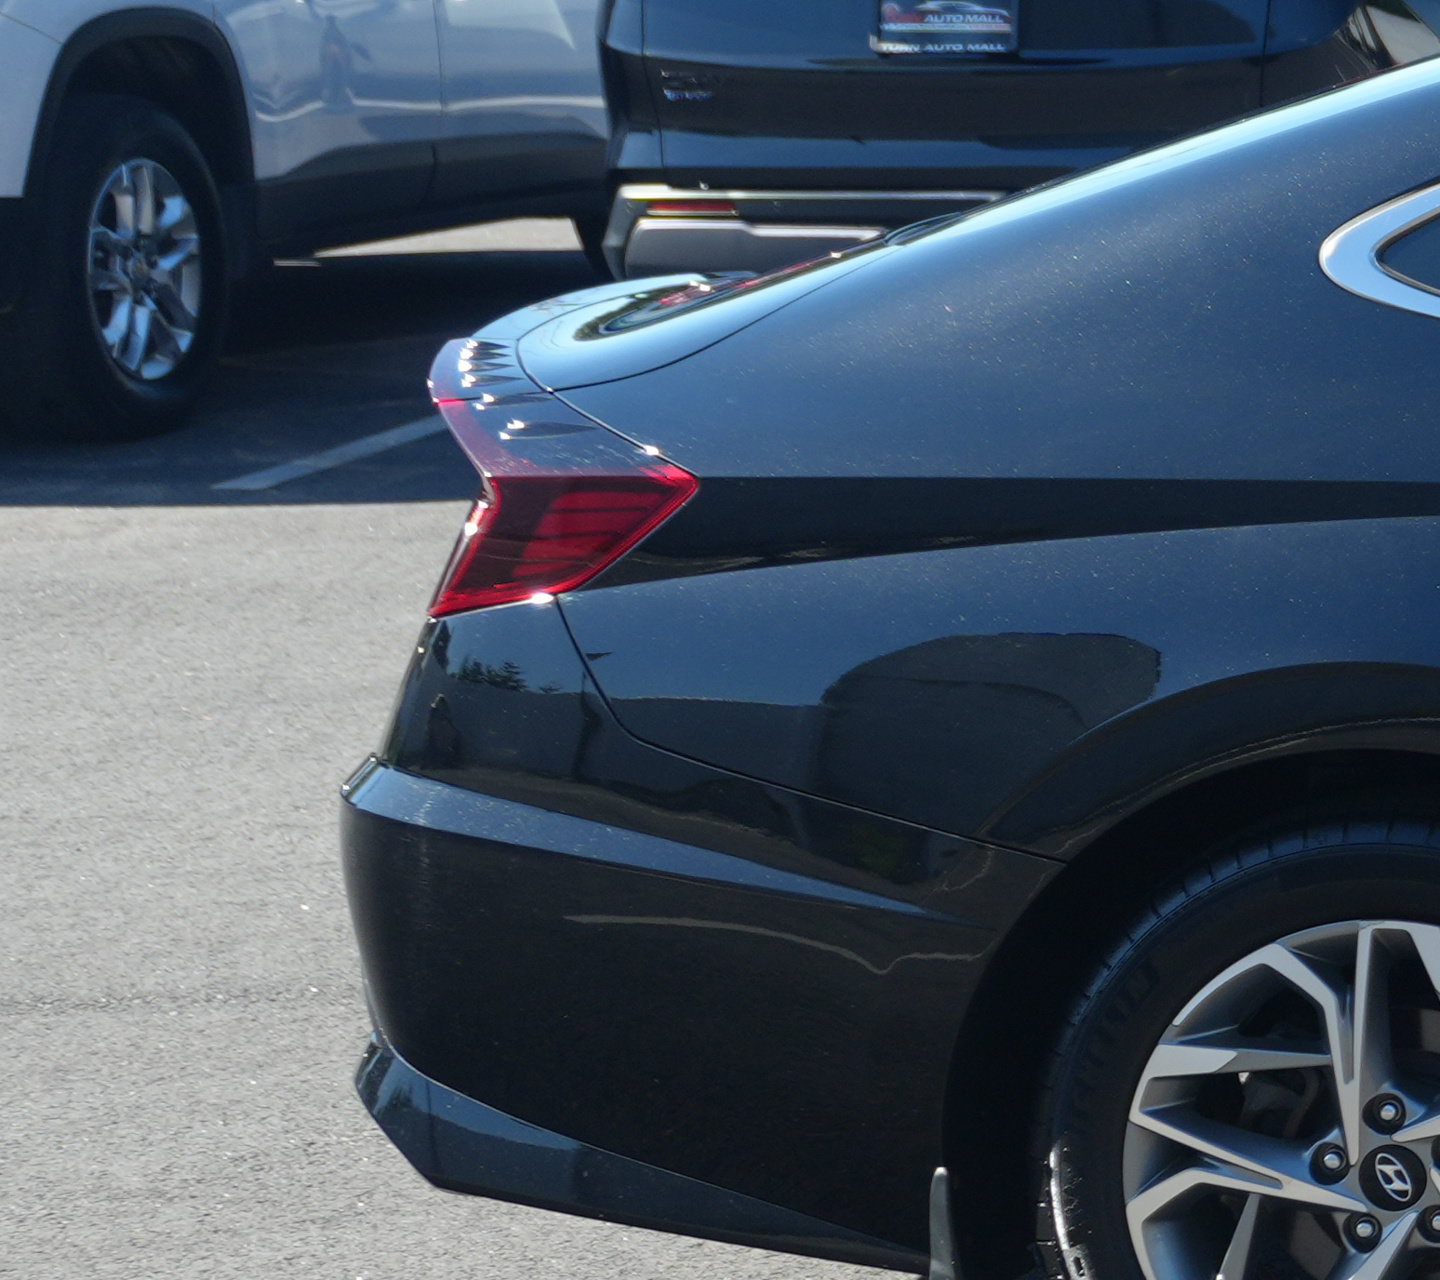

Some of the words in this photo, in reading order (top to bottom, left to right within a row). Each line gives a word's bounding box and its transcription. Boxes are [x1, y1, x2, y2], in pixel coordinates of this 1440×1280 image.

[924, 14, 963, 23] AUTO
[965, 14, 1004, 23] MALL
[923, 43, 963, 52] AUTO
[966, 43, 1005, 52] MALL
